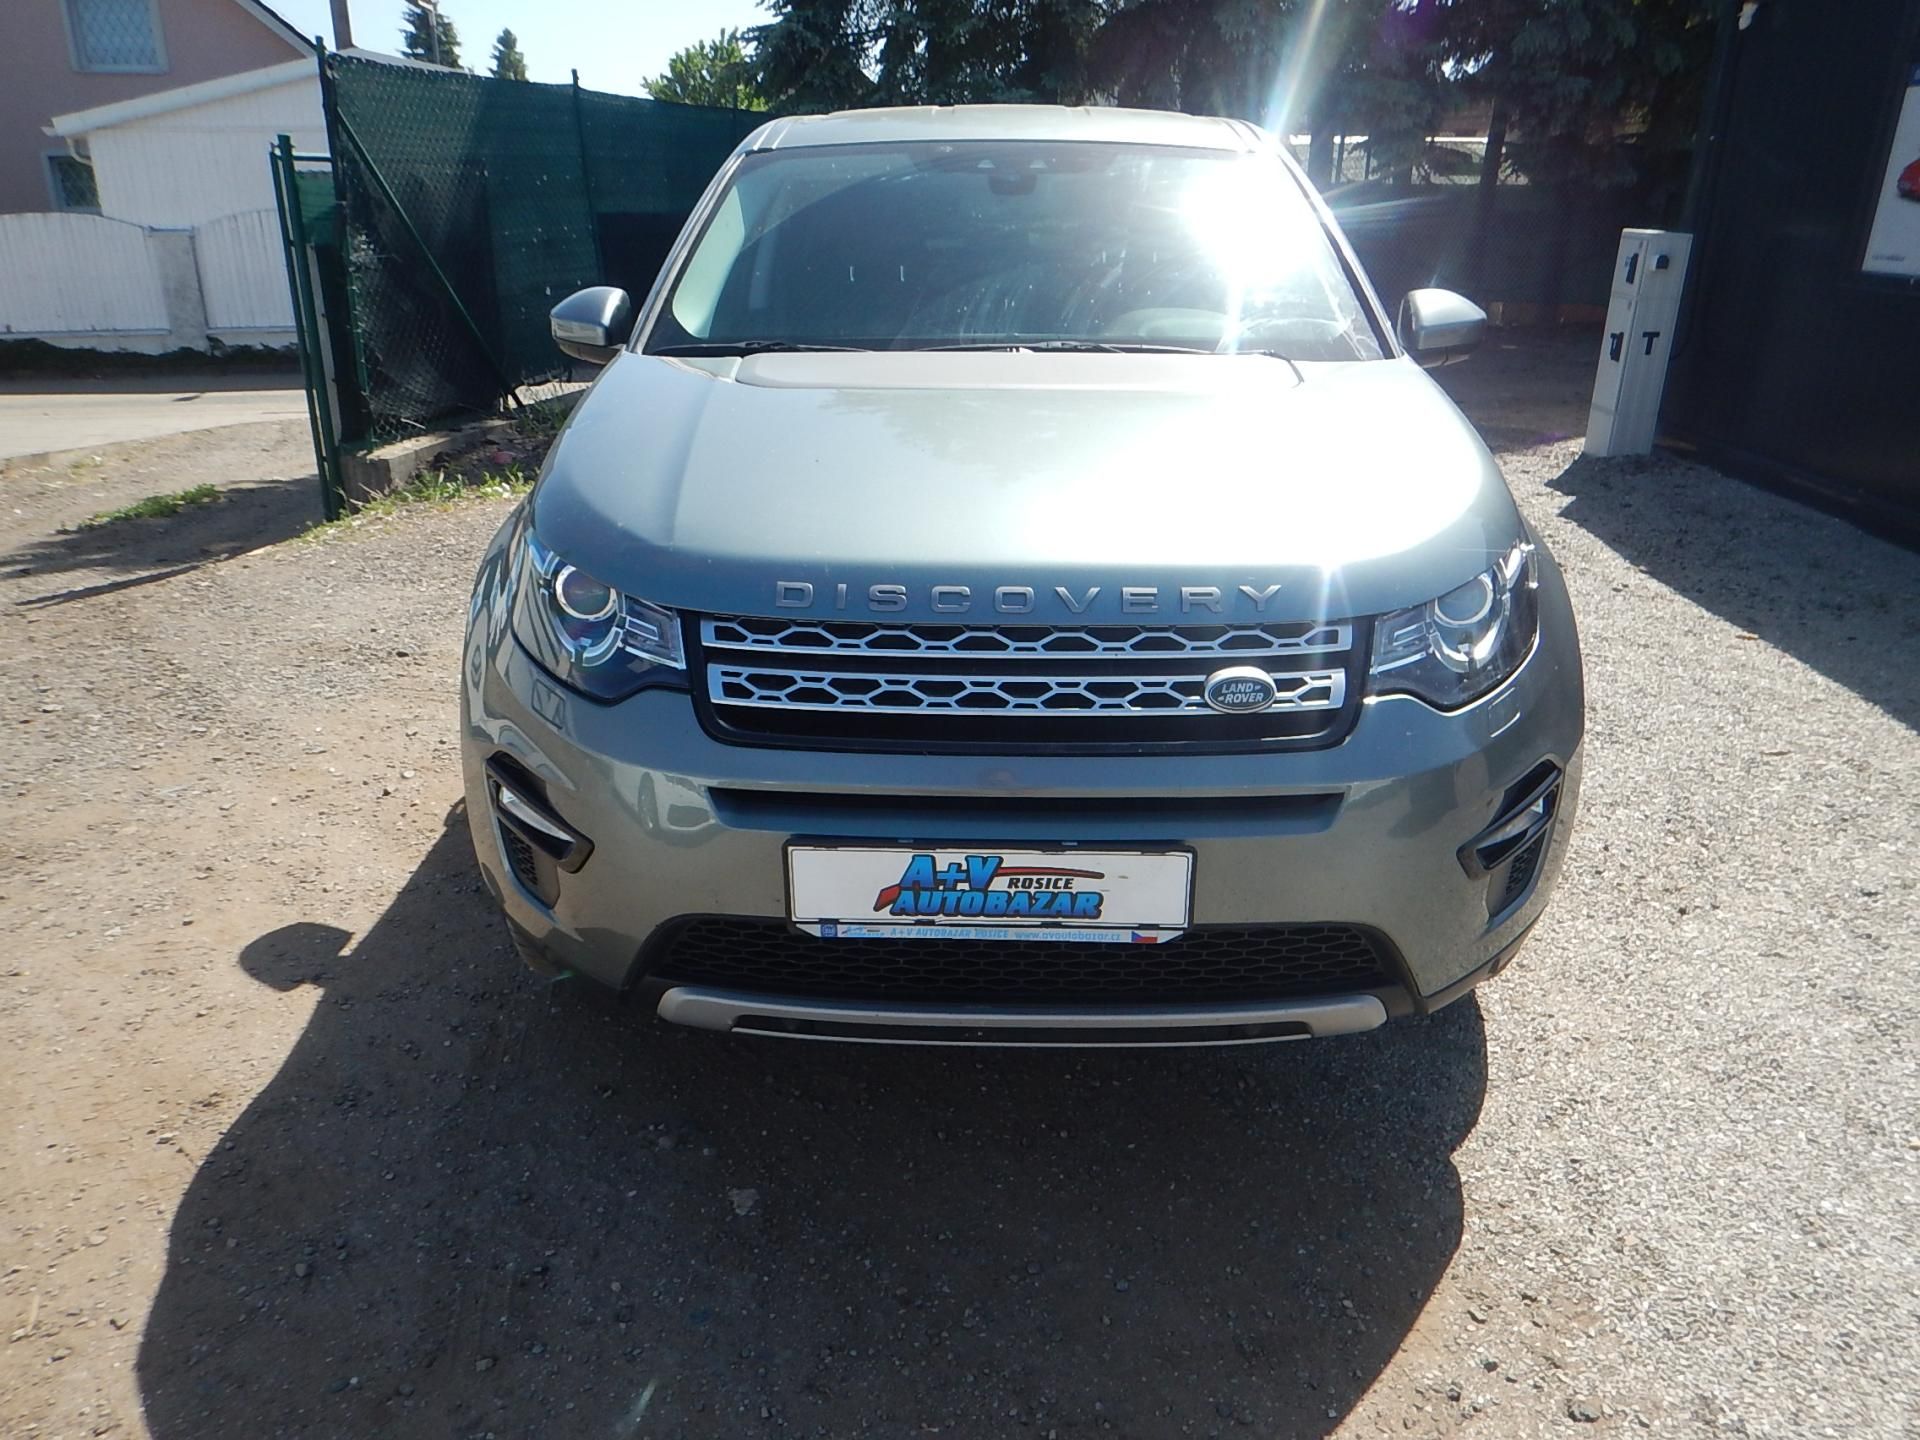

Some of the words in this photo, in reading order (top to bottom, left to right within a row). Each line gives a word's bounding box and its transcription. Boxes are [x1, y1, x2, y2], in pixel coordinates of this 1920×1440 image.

[776, 581, 1282, 613] DISCOVERY
[1222, 682, 1253, 694] LAND
[1224, 692, 1264, 704] ROVER
[899, 854, 1004, 892] A+V
[1007, 877, 1073, 890] ROSICE
[890, 890, 1105, 918] AUTOBAZAR
[915, 929, 971, 938] AUTOBAZAR
[975, 930, 1008, 938] ROSICE
[1014, 931, 1120, 941] www.avautobazar.cz
